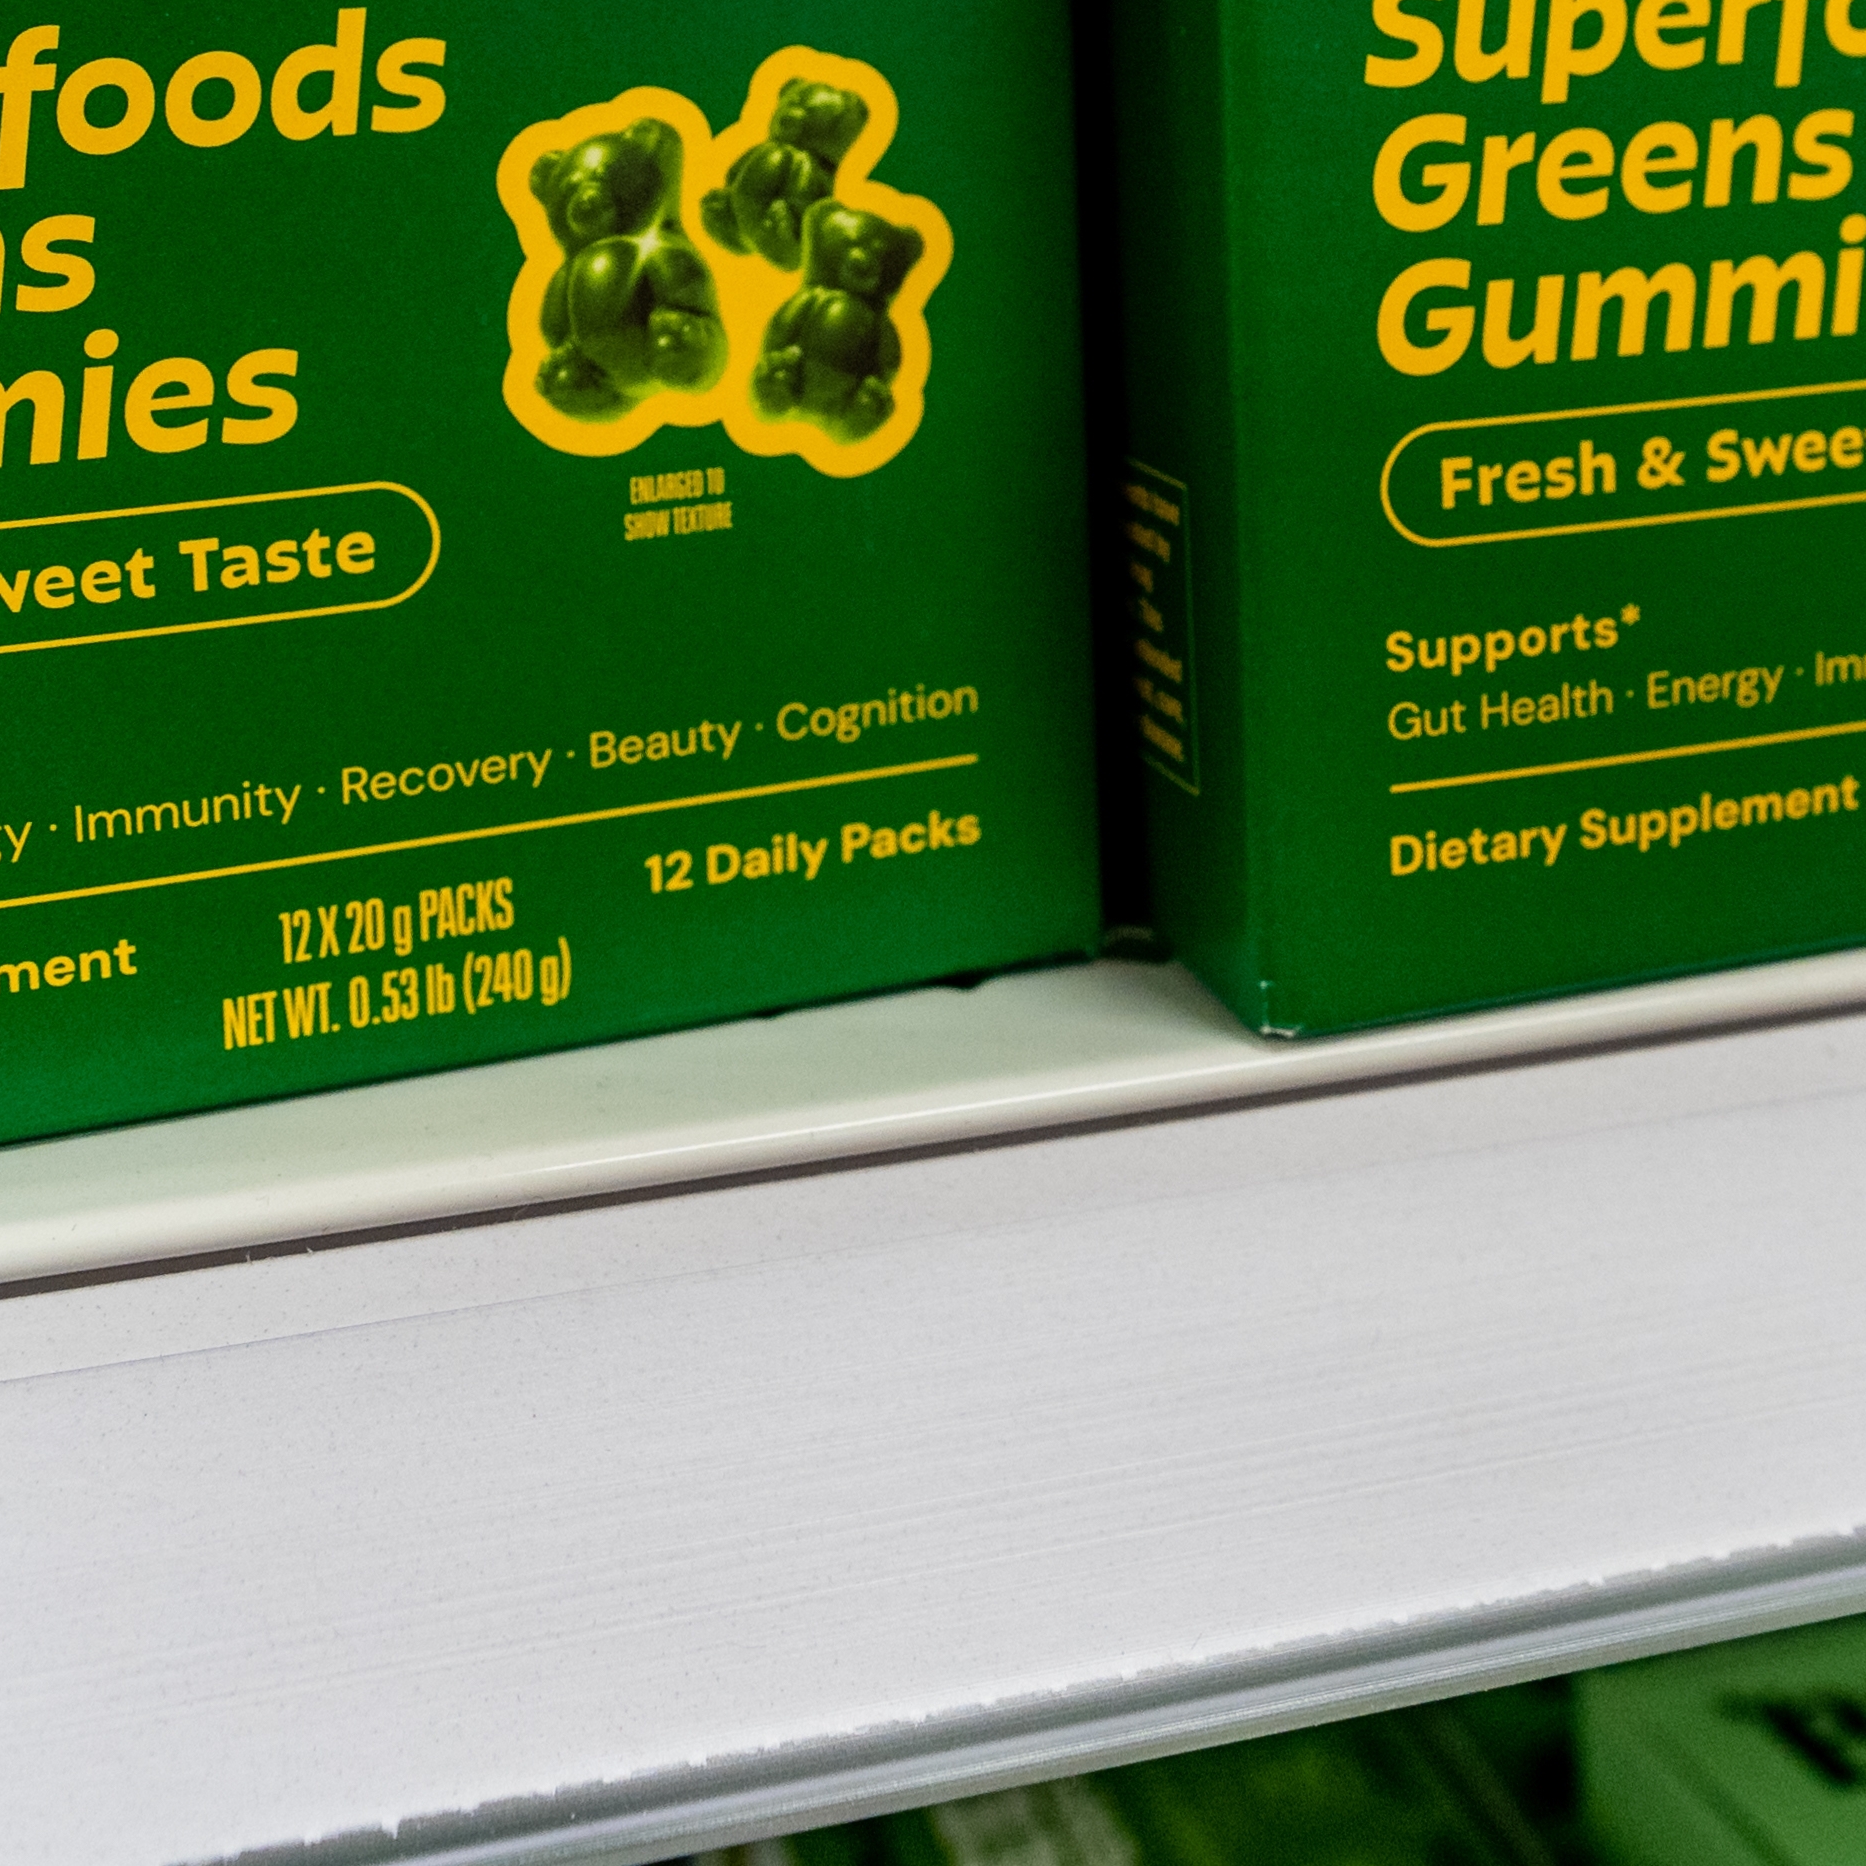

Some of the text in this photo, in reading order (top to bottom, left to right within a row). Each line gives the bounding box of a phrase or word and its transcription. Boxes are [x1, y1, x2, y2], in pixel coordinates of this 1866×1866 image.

[1373, 108, 1854, 232] Greens
[1441, 440, 1616, 509] Fresh
[1637, 437, 1684, 489] &
[179, 529, 375, 591] Taste
[1388, 701, 1465, 740] Gut
[1481, 680, 1613, 728] Health
[1648, 667, 1783, 708] Energy
[75, 784, 301, 842] Immunity
[342, 749, 552, 804] Recovery
[590, 721, 741, 768] Beauty
[777, 687, 977, 742] Cognition
[645, 810, 980, 893] 12 Daily Packs
[1390, 776, 1859, 875] Dietary Supplement
[279, 877, 514, 963] 12 X 20 g PACKS
[223, 937, 571, 1050] NET WT. 0.53 lb (240 g)
